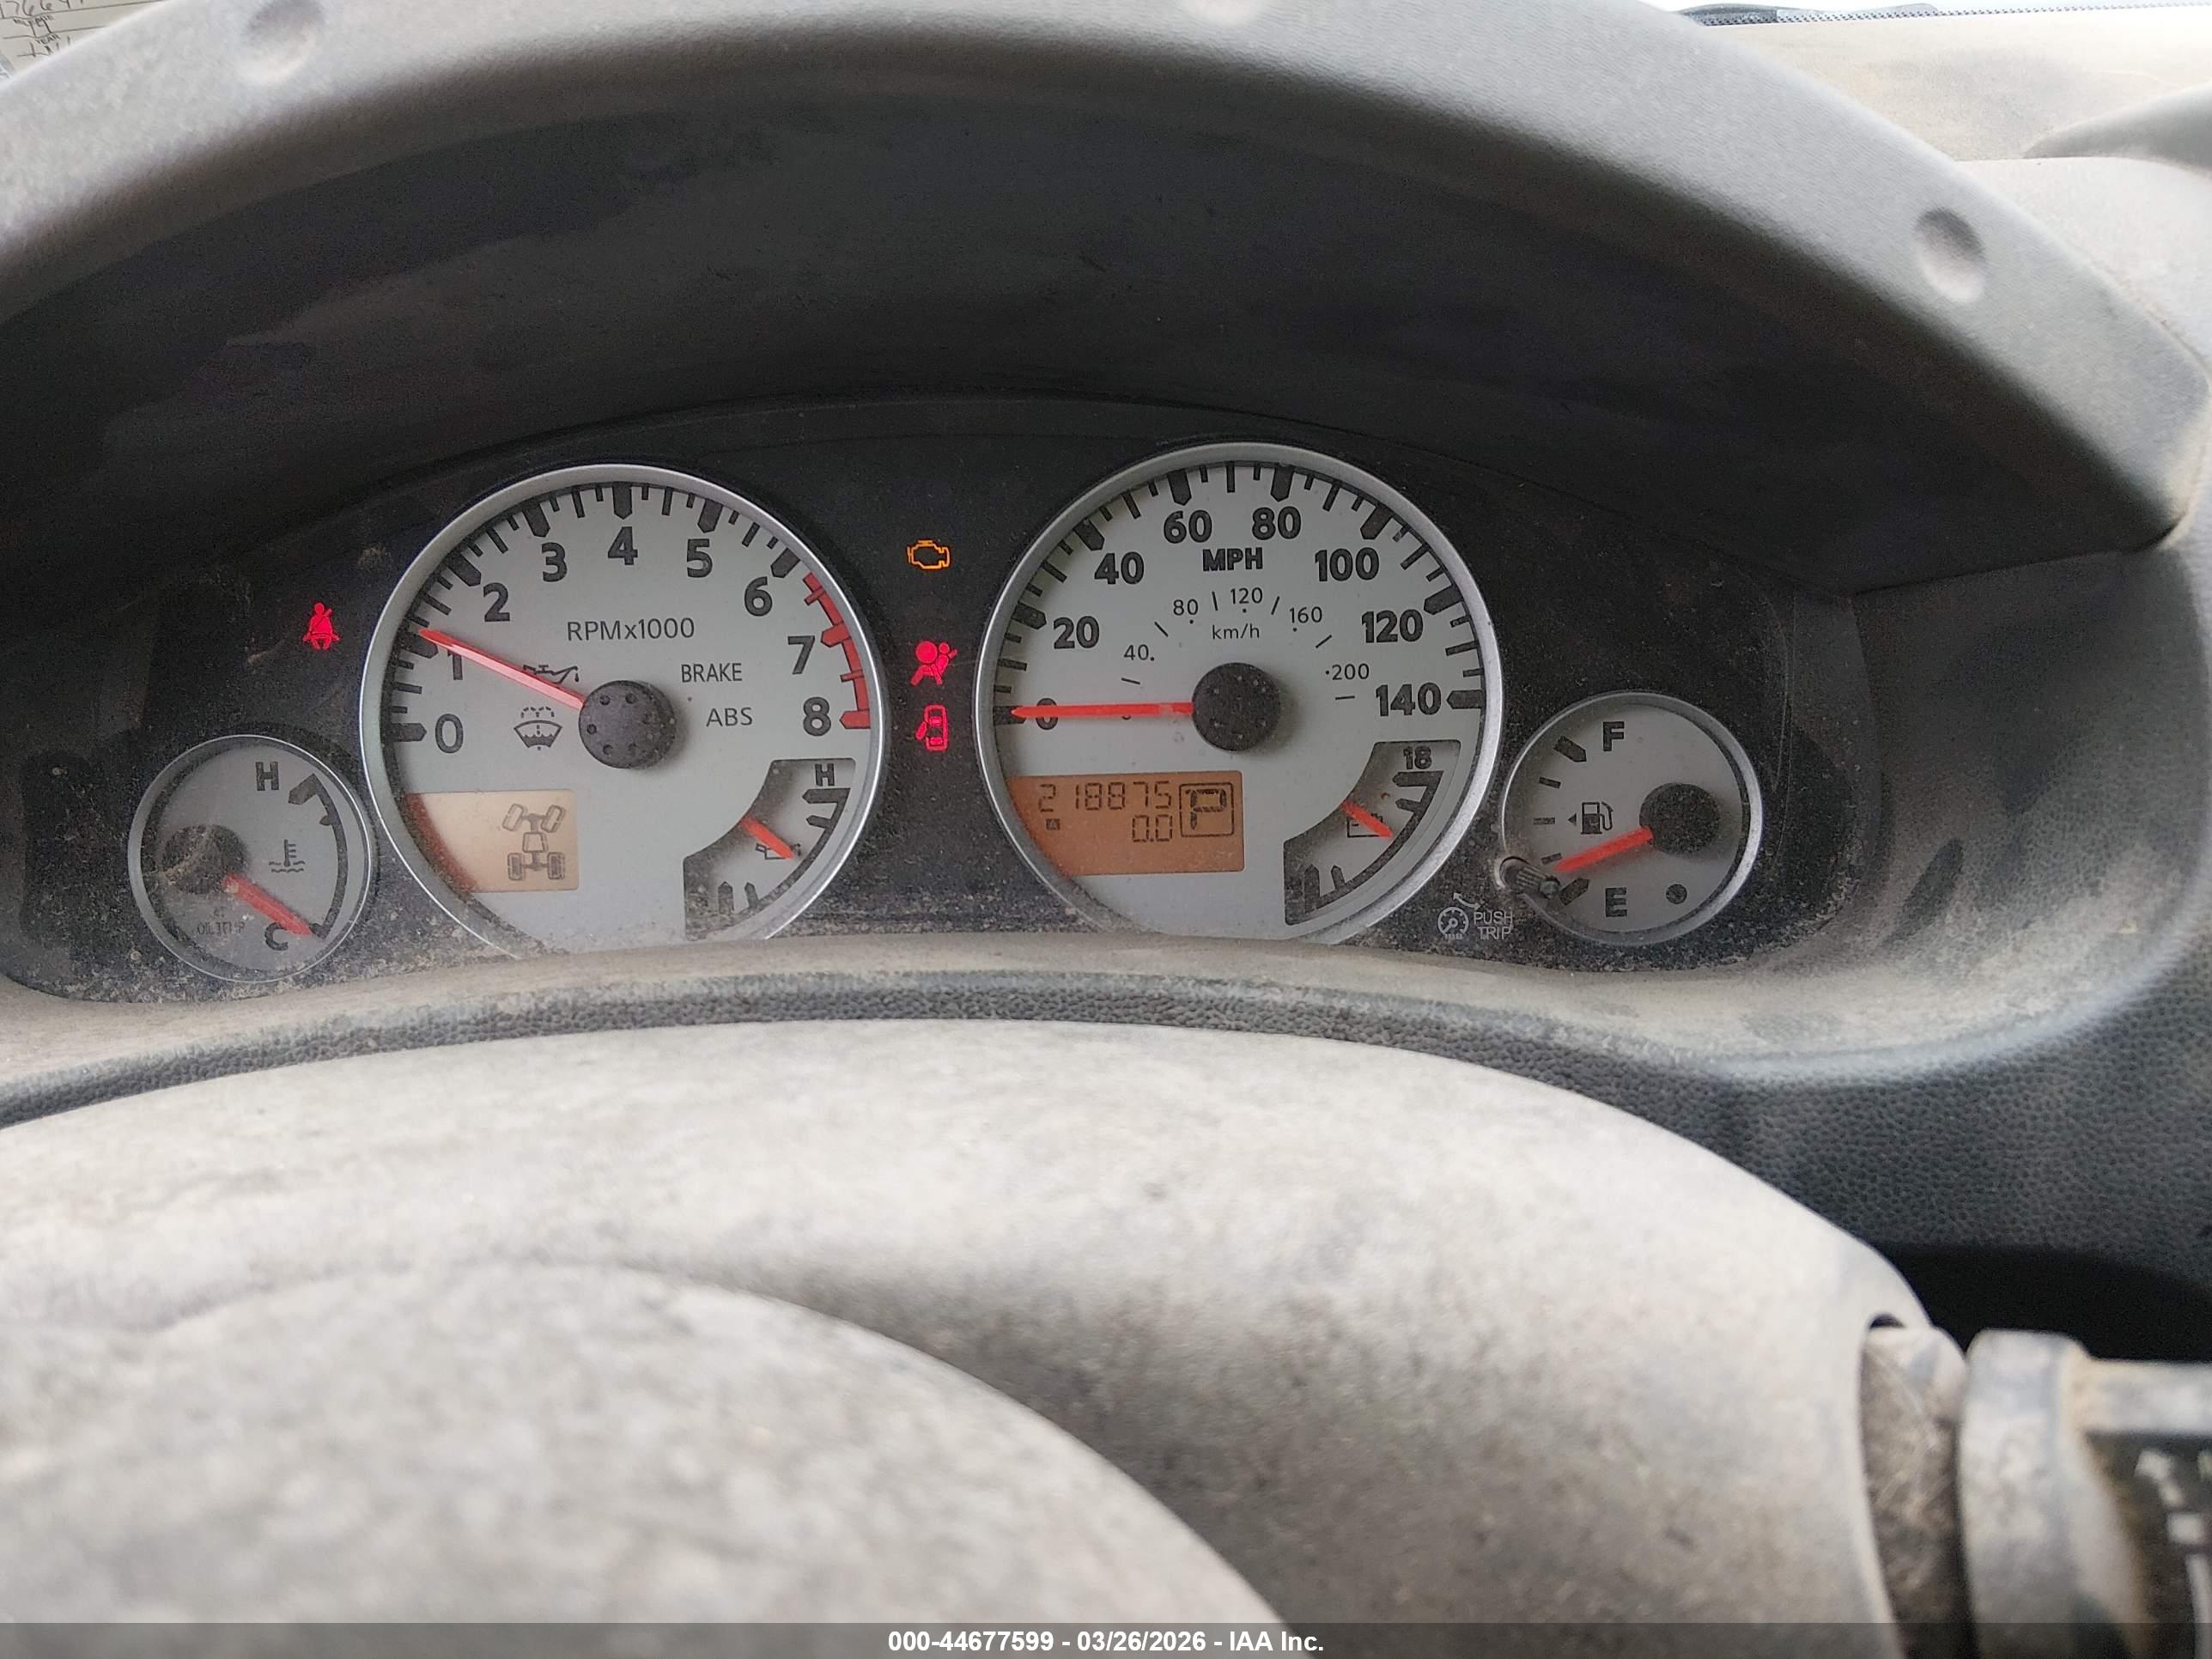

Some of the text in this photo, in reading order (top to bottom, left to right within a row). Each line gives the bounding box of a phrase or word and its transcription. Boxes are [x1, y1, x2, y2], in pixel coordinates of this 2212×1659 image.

[1163, 509, 1212, 543] 60
[1251, 506, 1302, 541] 80
[607, 526, 639, 566] 4
[686, 538, 714, 579] 5
[1202, 546, 1263, 572] MPH
[541, 542, 568, 583] 3
[1095, 552, 1145, 585] 40
[1314, 547, 1380, 582] 100
[483, 582, 511, 623] 2
[744, 577, 773, 617] 6
[1173, 599, 1199, 617] 80
[1230, 586, 1263, 605] 120
[567, 617, 695, 641] RPMx1000
[1289, 606, 1323, 623] 160
[1362, 611, 1422, 644] 120
[1053, 616, 1100, 650] 20
[1212, 623, 1260, 640] km/h
[447, 648, 464, 681] 1
[787, 635, 816, 675] 7
[1123, 644, 1149, 661] 40
[681, 662, 743, 684] BRAKE
[1332, 663, 1370, 681] 200
[1375, 682, 1442, 717] 140
[706, 707, 753, 727] ABS
[802, 696, 832, 737] 8
[434, 713, 464, 754] 0
[1602, 720, 1625, 752] F
[1402, 745, 1432, 770] 18
[255, 761, 280, 792] H
[814, 763, 836, 787] H
[1038, 781, 1173, 812] 218875
[1131, 814, 1174, 842] 0.0
[1474, 909, 1514, 926] PUSH
[1604, 887, 1628, 918] E
[264, 921, 289, 951] C
[1477, 926, 1512, 941] TRIP
